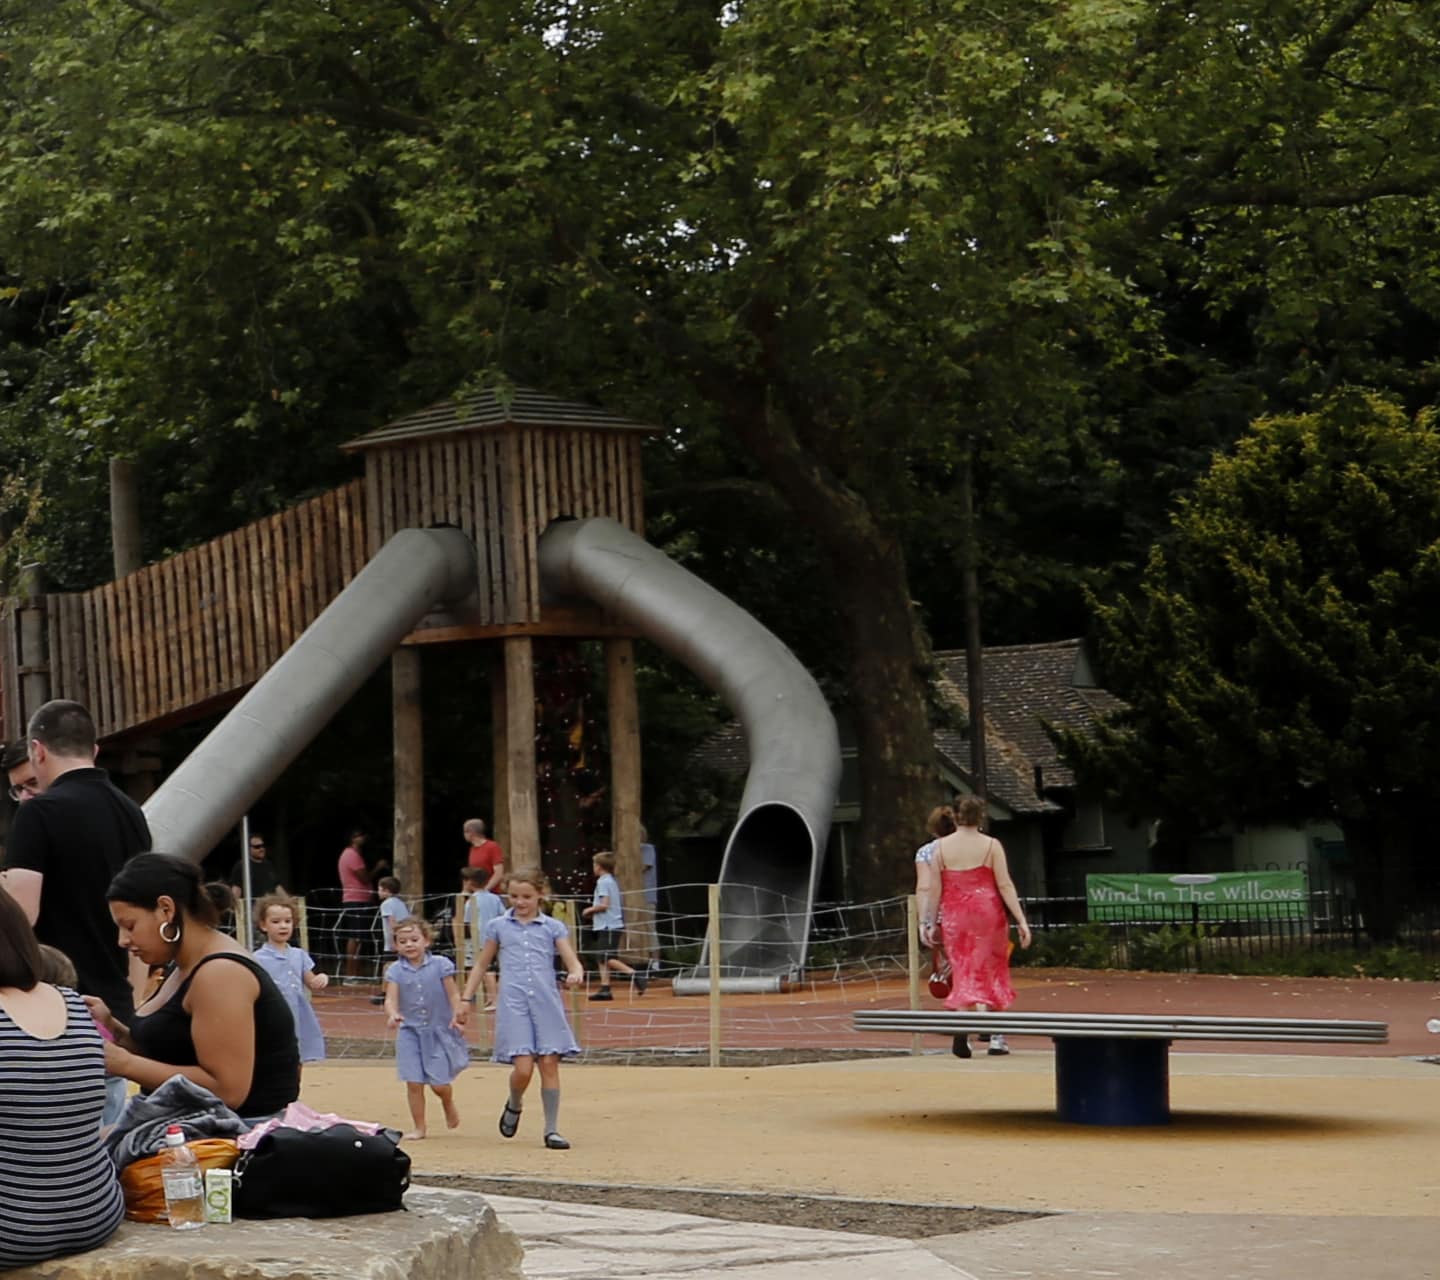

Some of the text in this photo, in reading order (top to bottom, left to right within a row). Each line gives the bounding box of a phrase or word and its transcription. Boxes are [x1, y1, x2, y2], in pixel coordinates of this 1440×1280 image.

[1089, 880, 1303, 902] Wind In The Willows
